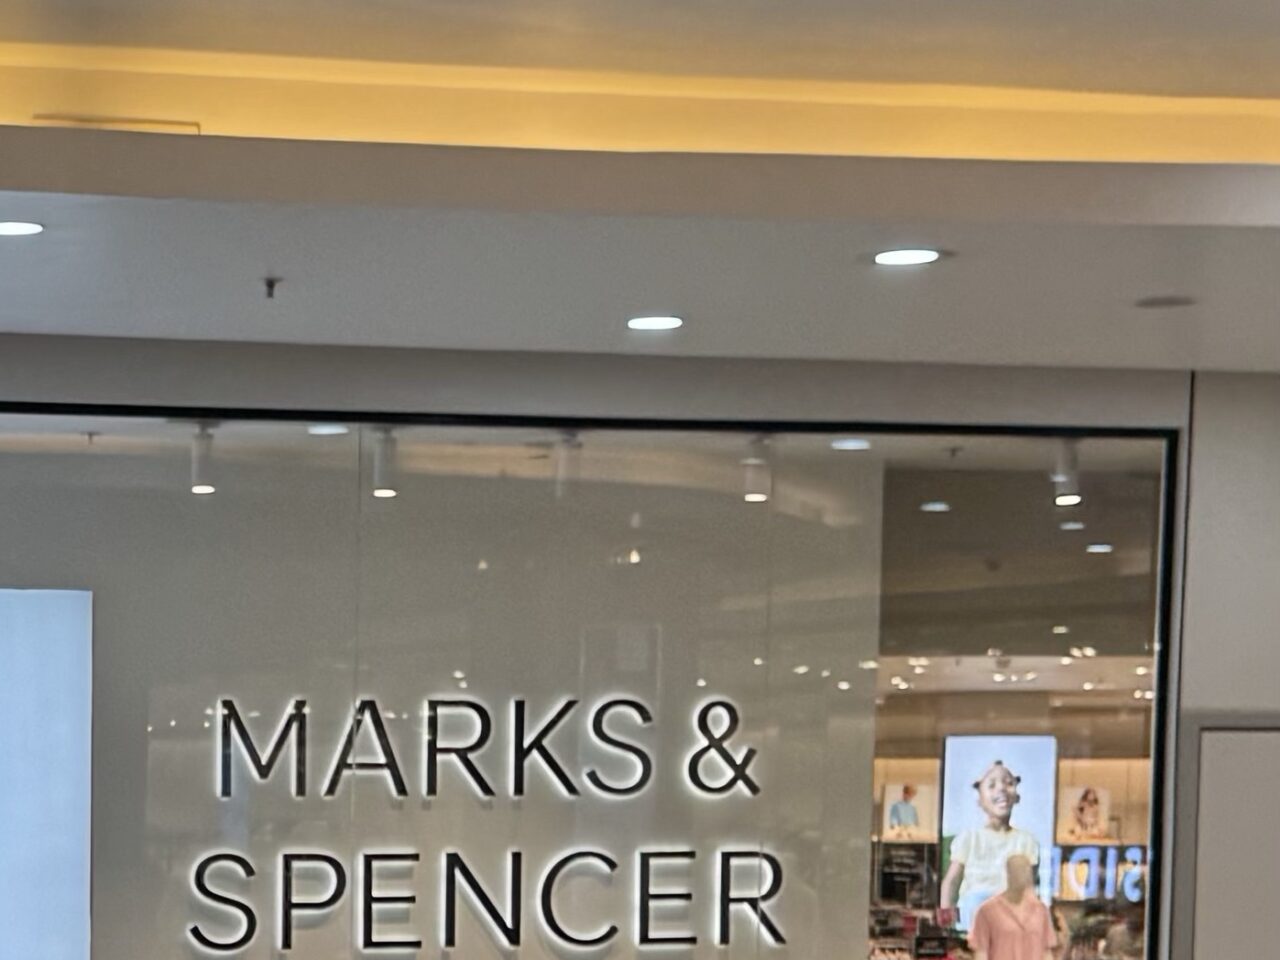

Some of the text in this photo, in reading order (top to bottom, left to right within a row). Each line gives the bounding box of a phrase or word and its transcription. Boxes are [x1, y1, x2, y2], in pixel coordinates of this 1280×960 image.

[214, 698, 762, 799] MARKS &
[187, 850, 788, 953] SPENCER
